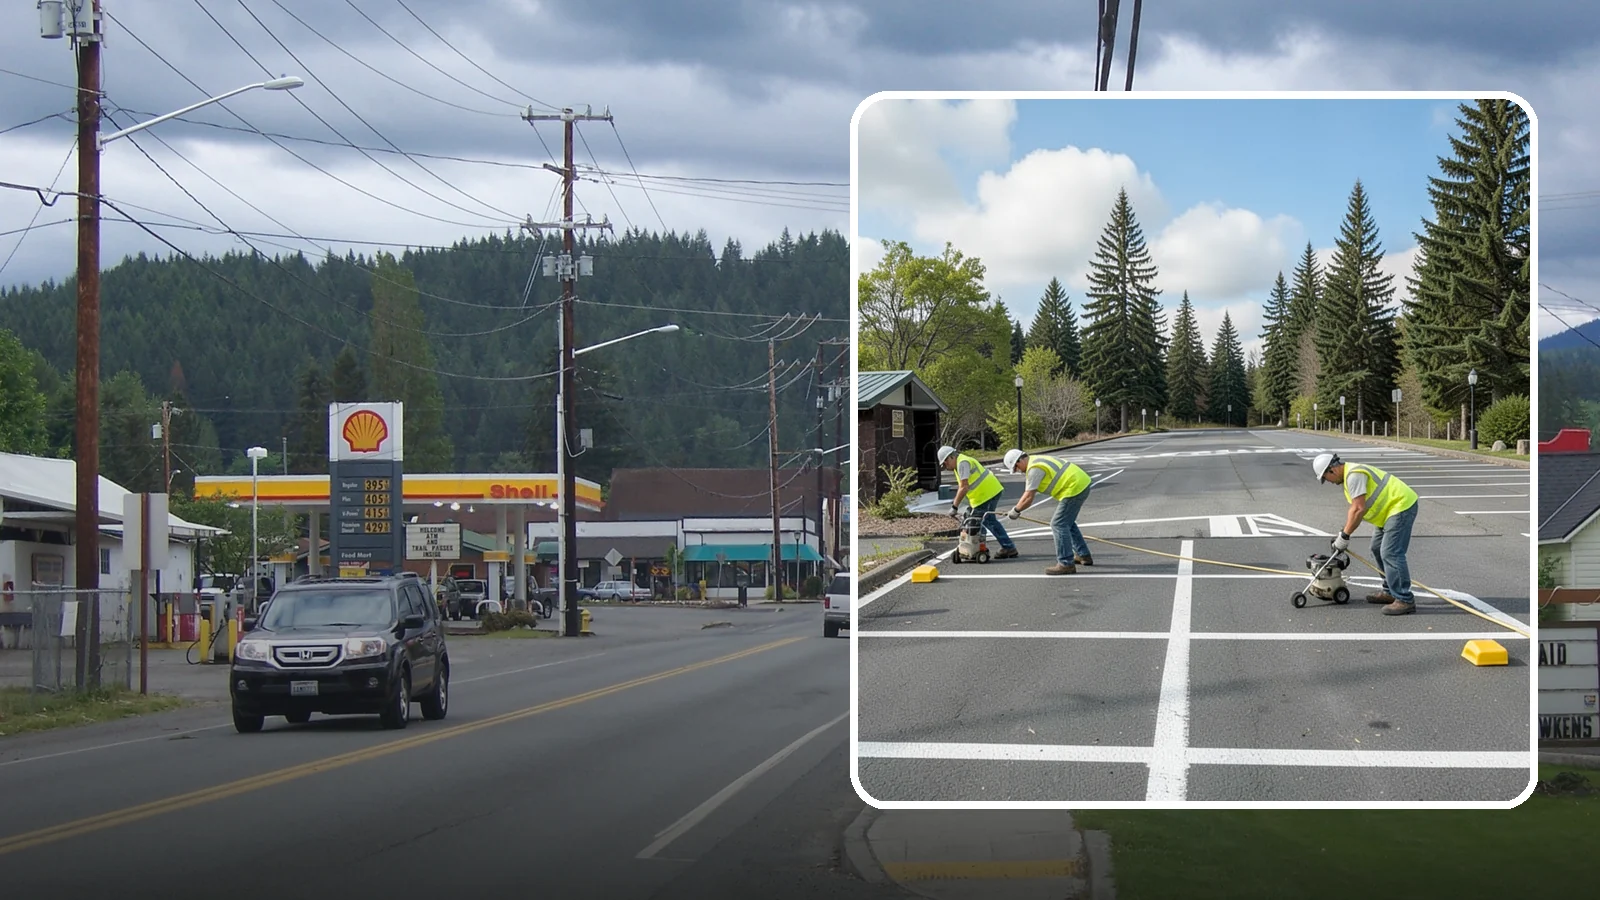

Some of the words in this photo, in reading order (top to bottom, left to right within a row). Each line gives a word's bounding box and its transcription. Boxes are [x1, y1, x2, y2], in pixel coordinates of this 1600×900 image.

[366, 480, 383, 490] 395
[490, 484, 547, 499] Shell
[366, 494, 383, 504] 405
[366, 508, 383, 518] 415
[366, 522, 383, 532] 429
